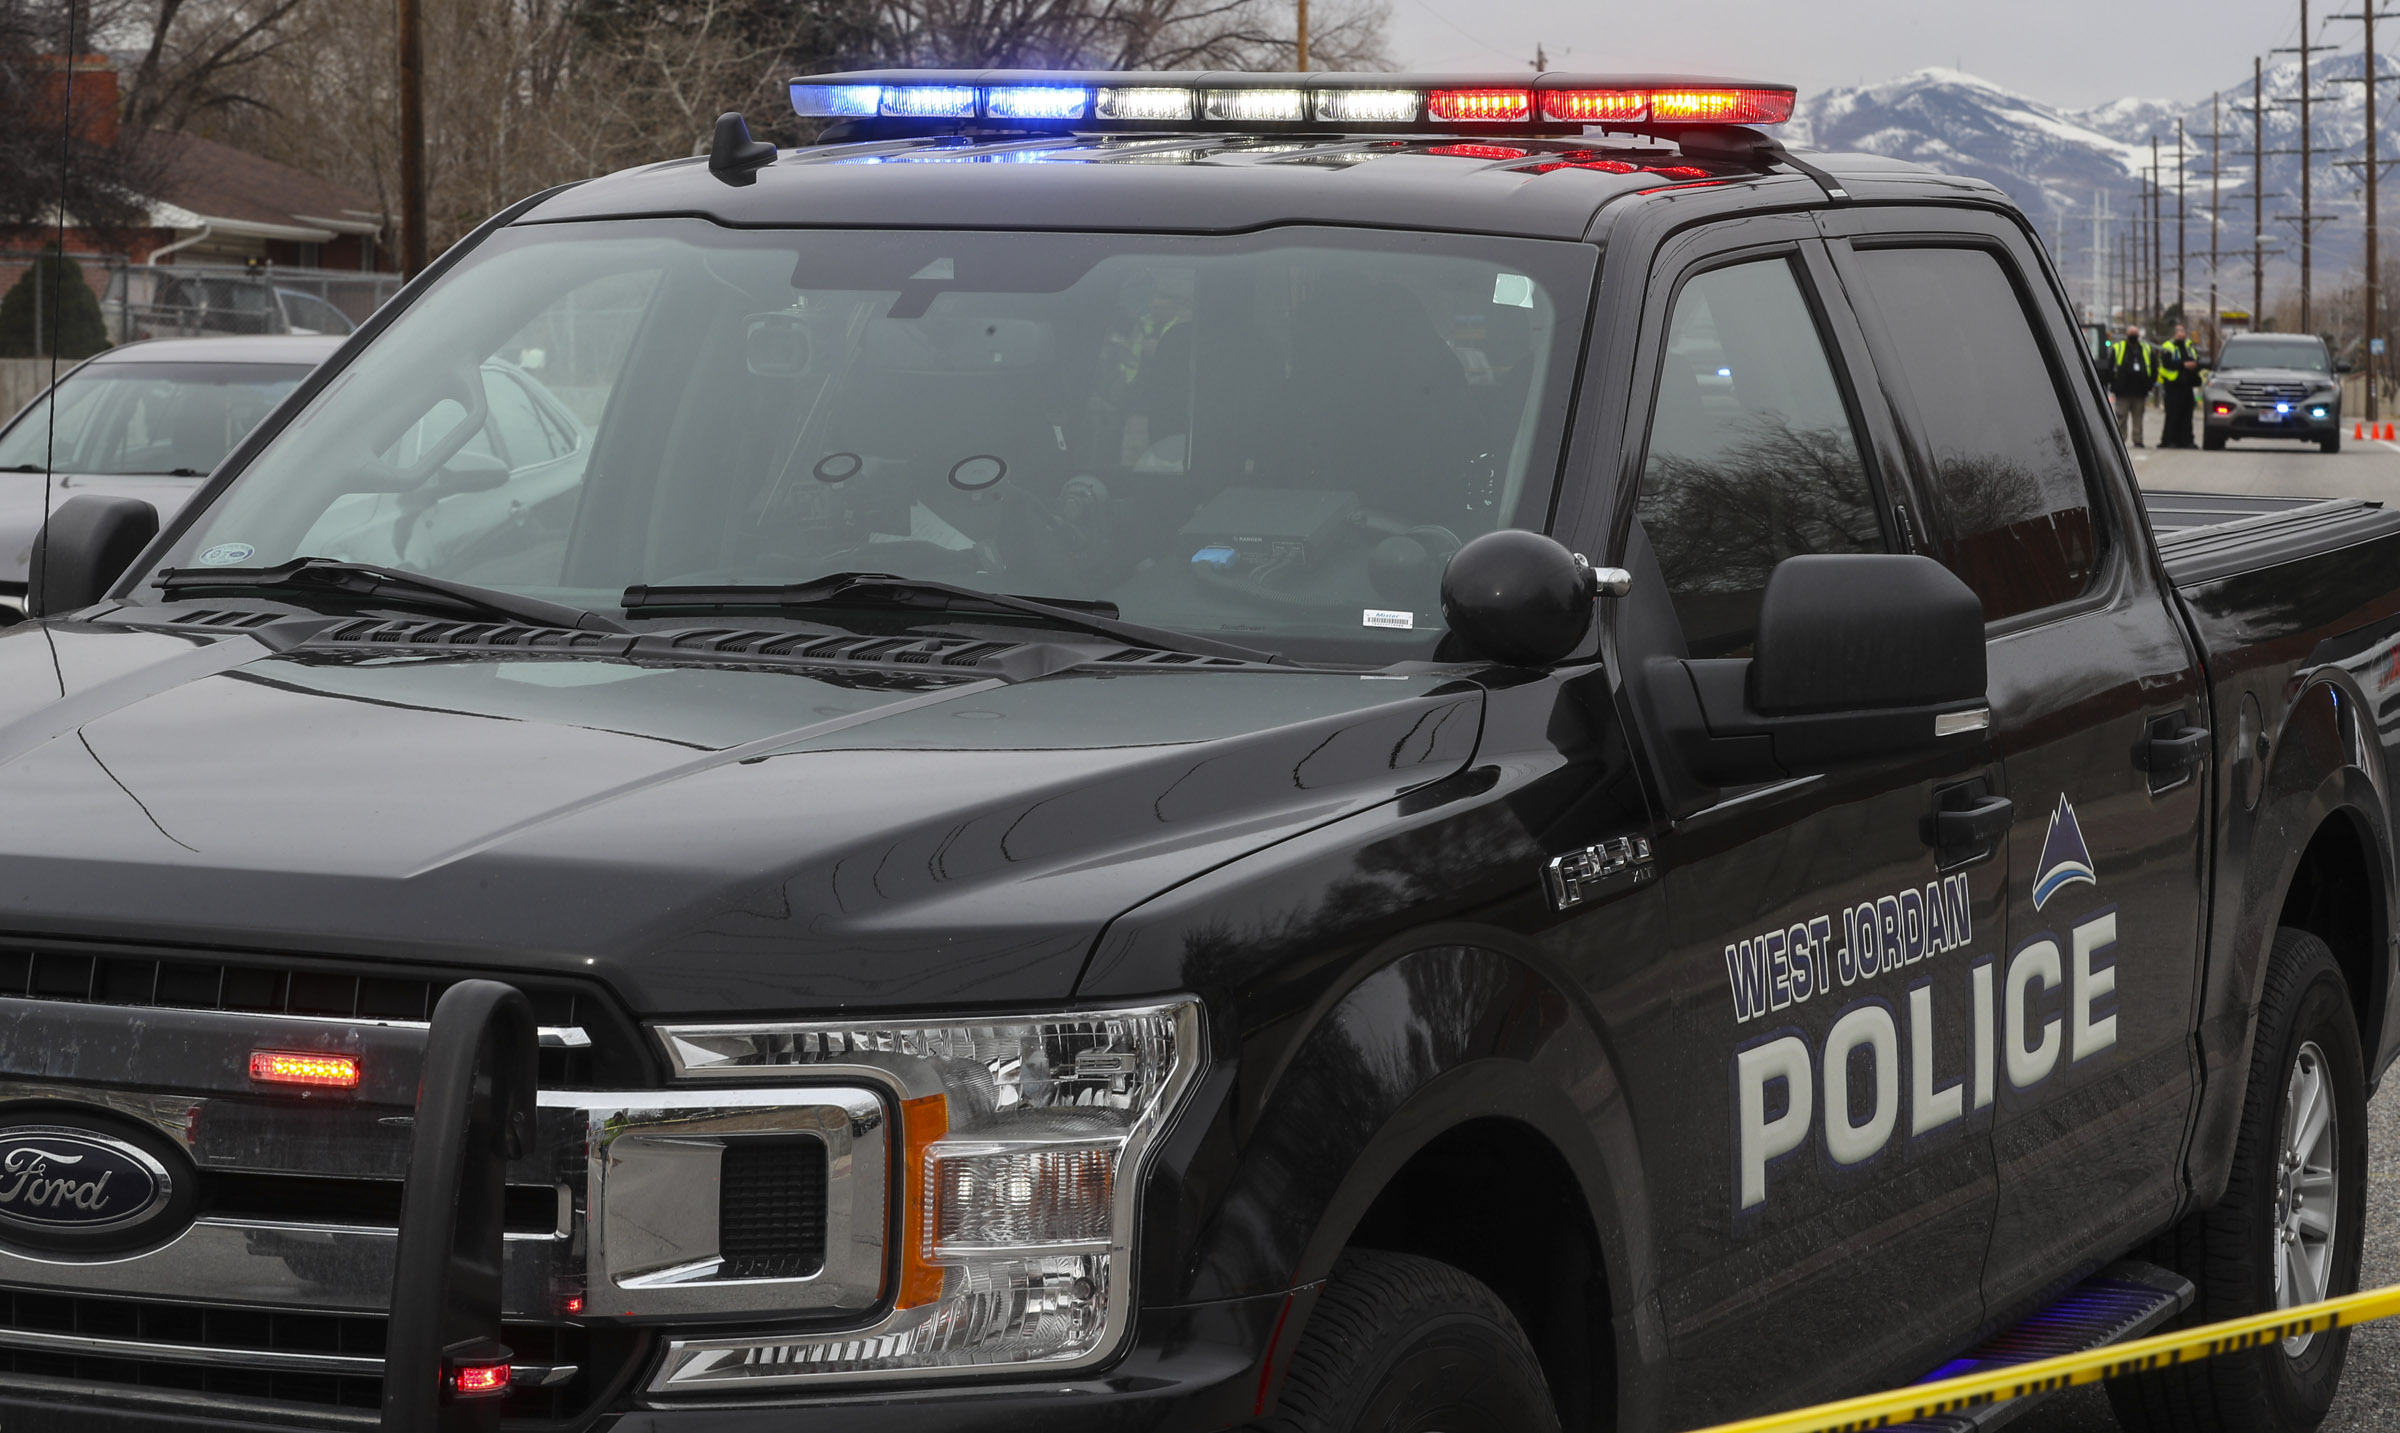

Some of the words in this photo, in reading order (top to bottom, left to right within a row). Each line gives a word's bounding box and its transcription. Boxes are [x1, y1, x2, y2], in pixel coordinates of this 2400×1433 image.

[1725, 914, 1831, 1024] WEST
[1838, 872, 1972, 987] JORDAN
[1738, 912, 2117, 1211] POLICE
[0, 1147, 113, 1210] Ford
